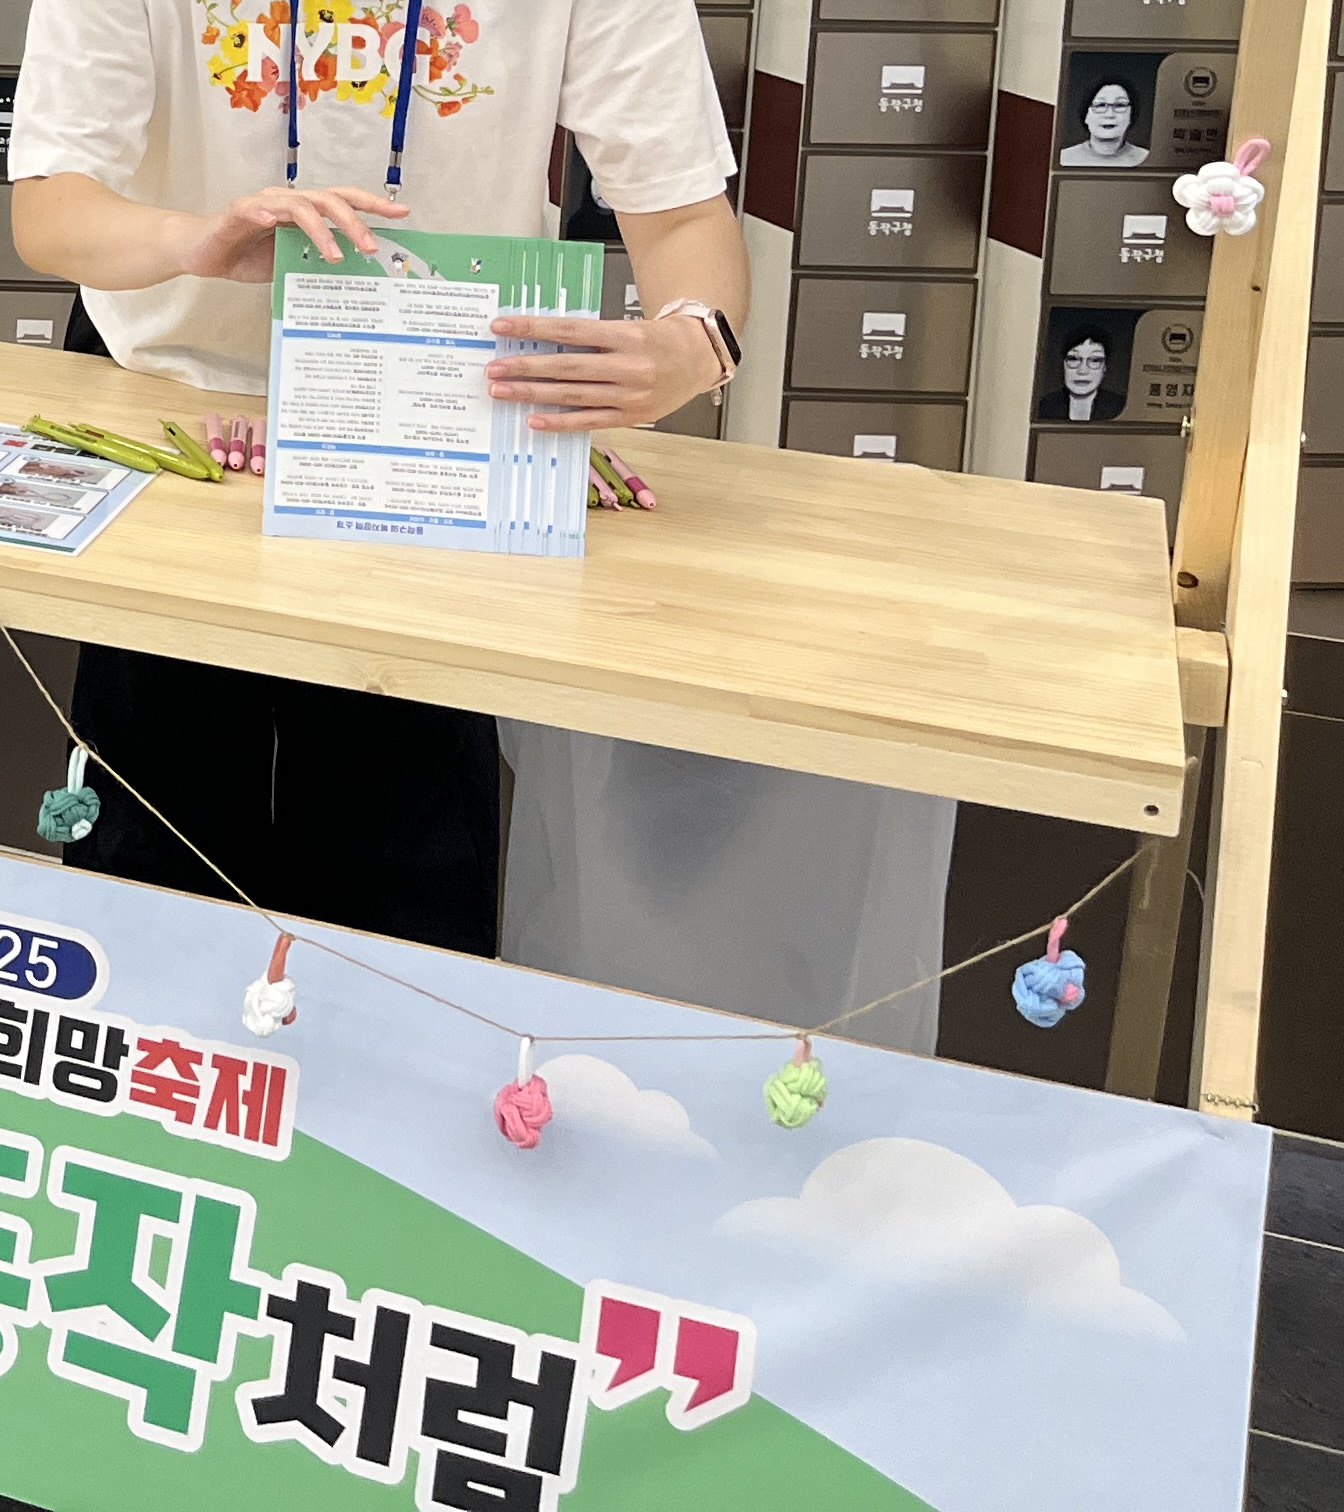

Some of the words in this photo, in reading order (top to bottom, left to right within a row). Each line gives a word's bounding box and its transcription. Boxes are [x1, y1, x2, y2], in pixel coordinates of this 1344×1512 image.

[246, 23, 431, 83] NYBG
[868, 221, 912, 235] 동작구청
[1119, 248, 1163, 263] 동작구청
